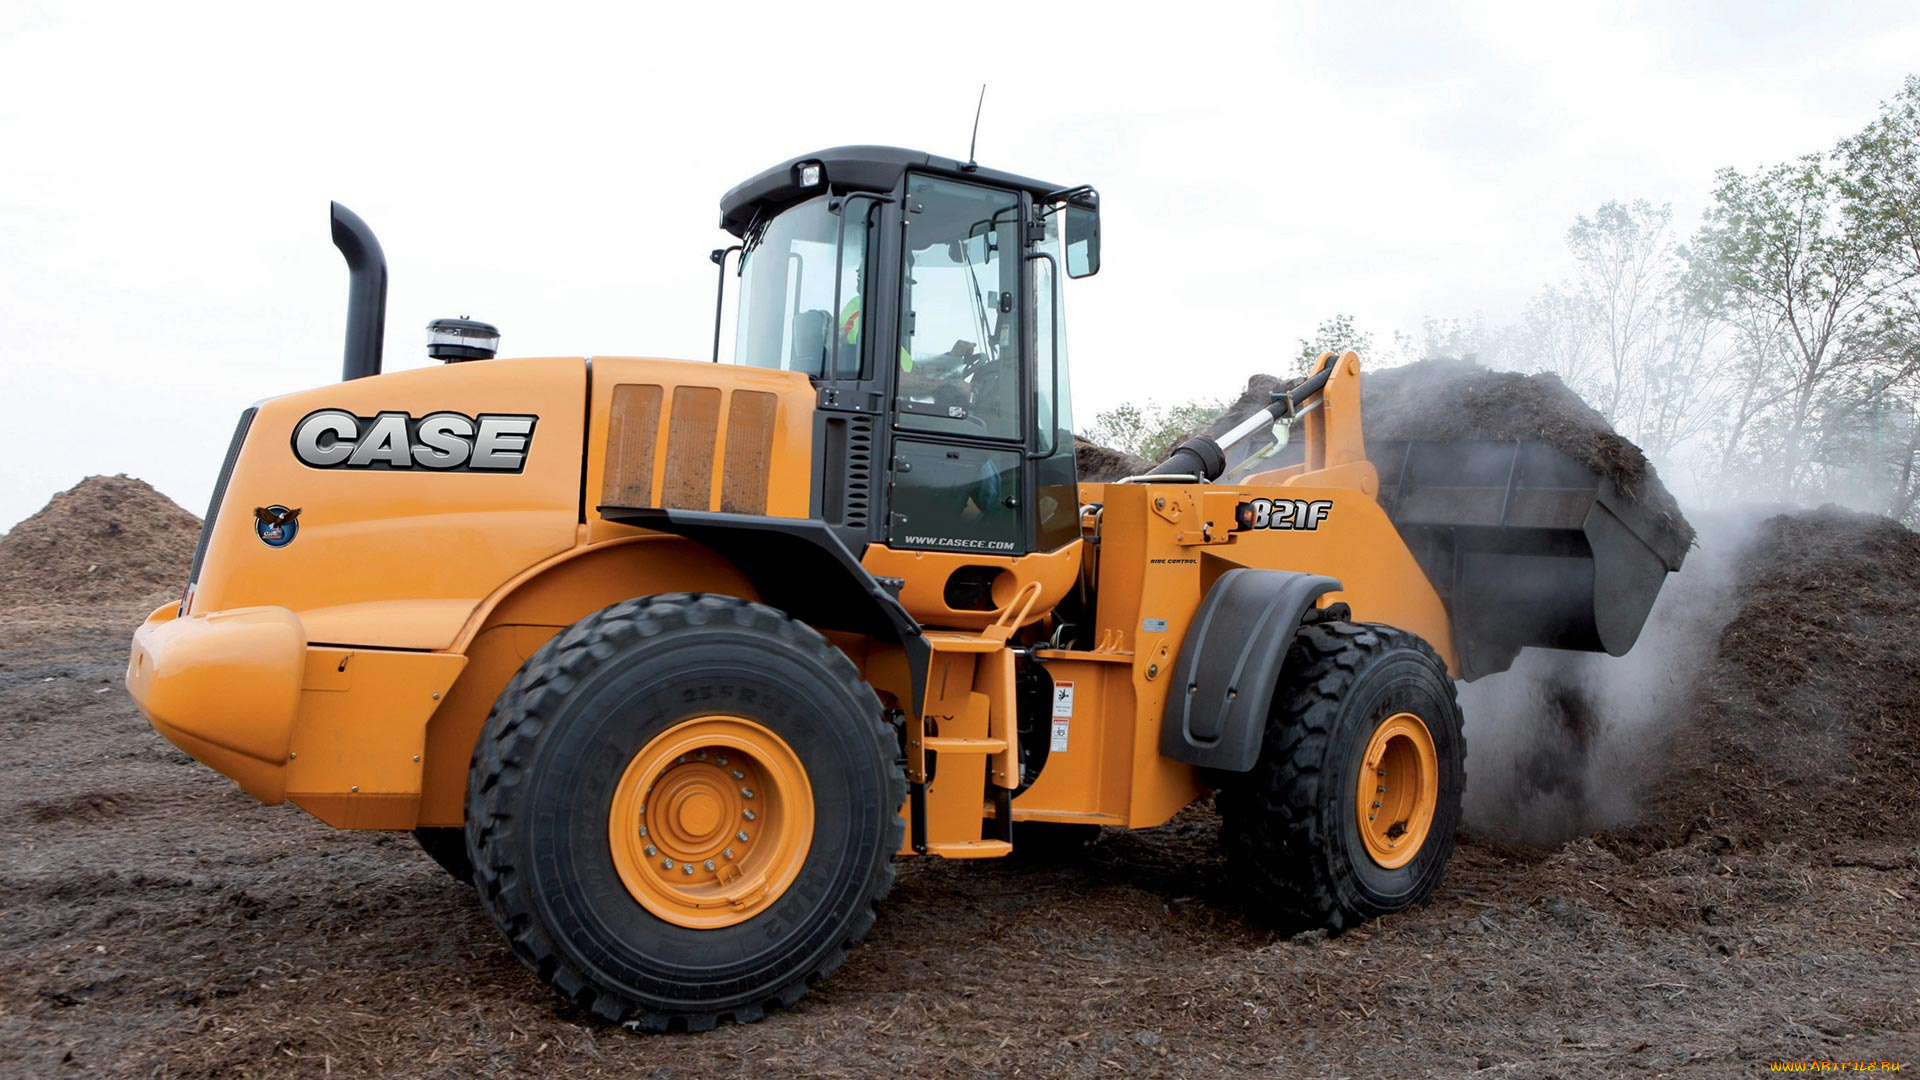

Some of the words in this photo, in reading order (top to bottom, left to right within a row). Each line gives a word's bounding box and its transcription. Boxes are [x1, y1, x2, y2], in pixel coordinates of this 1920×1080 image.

[294, 411, 535, 471] CASE
[1252, 498, 1332, 530] 821F
[905, 535, 1015, 550] WWW.CASECE.COM
